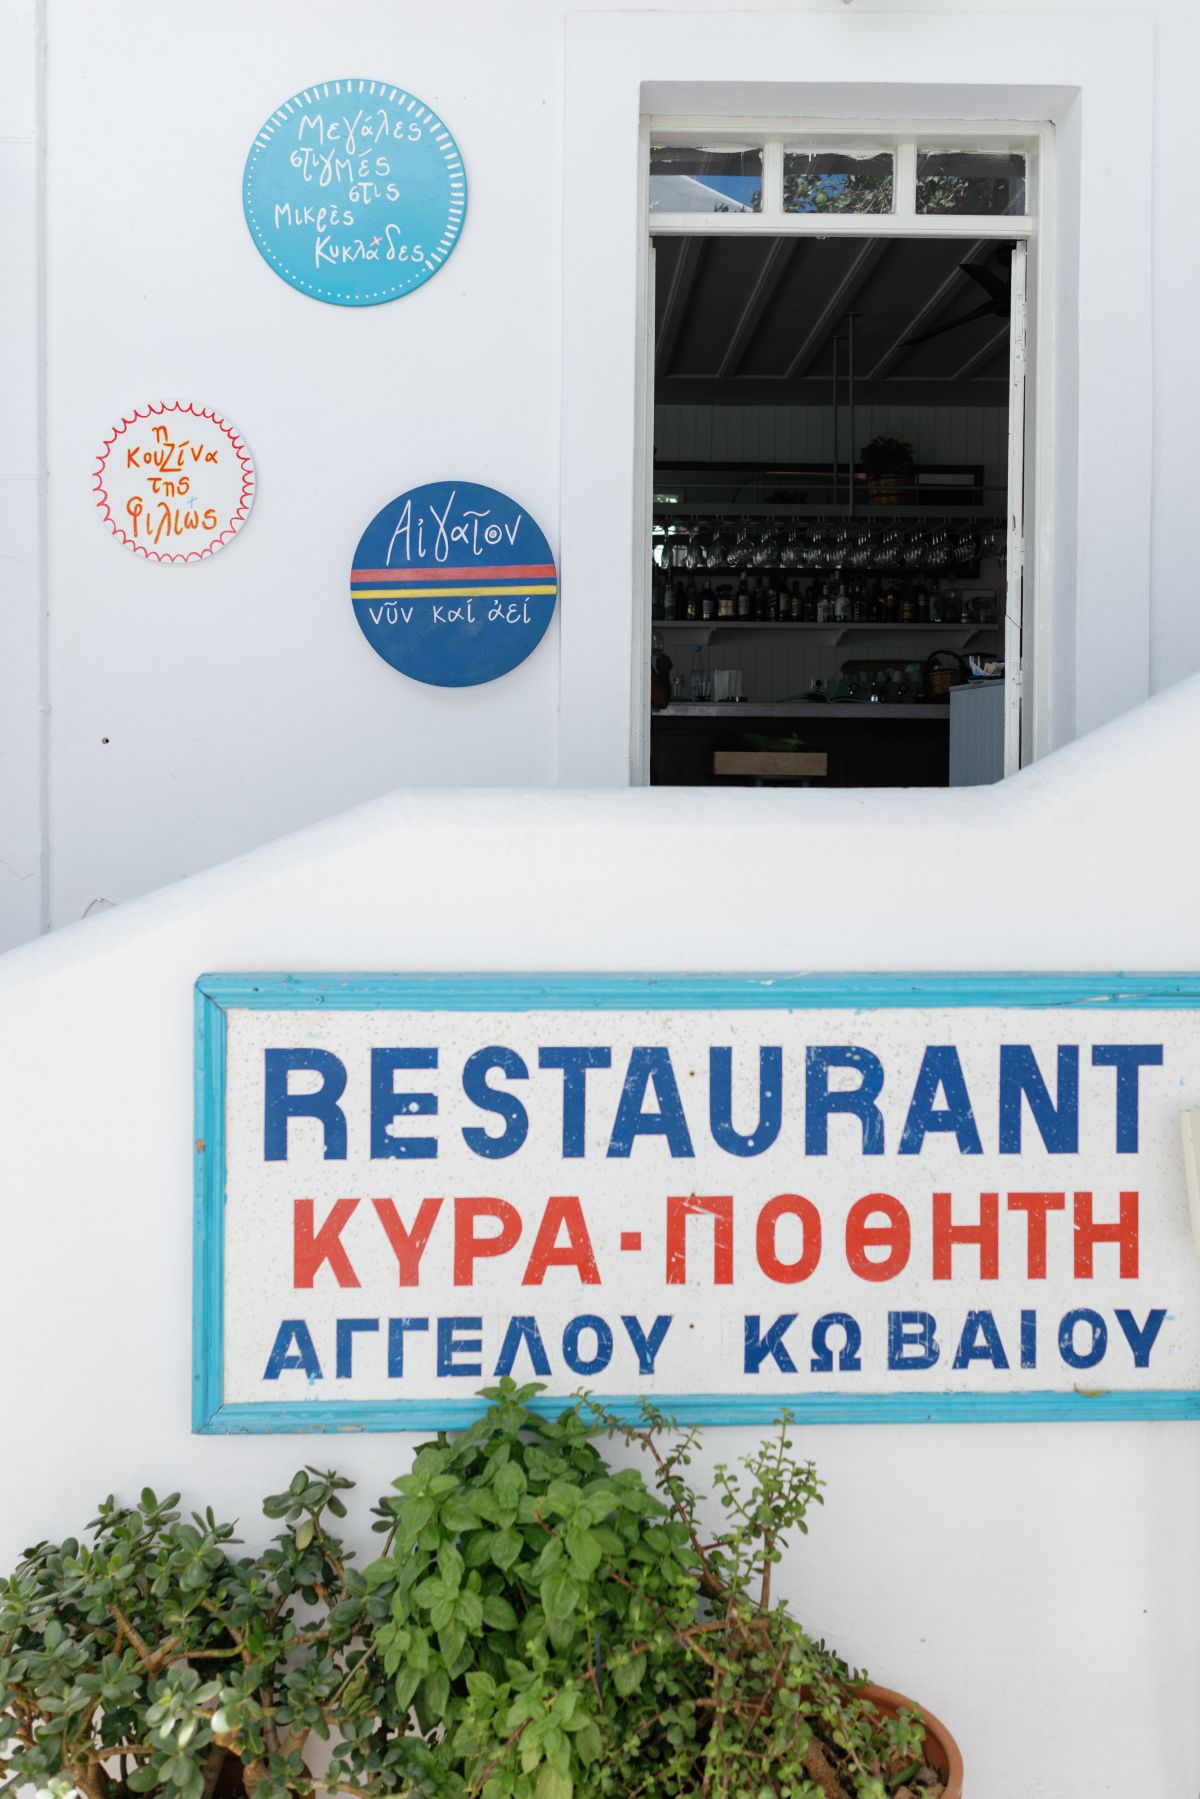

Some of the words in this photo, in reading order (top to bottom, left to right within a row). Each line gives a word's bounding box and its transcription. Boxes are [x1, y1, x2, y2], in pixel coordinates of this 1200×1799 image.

[298, 109, 422, 155] Μεγάλες
[349, 182, 400, 205] στις
[263, 1044, 1164, 1161] RESTAURANT
[263, 1314, 673, 1381] ΑΓΓΕΛΟΥ
[743, 1308, 1168, 1375] ΚΩΒΑΙΟΥ
